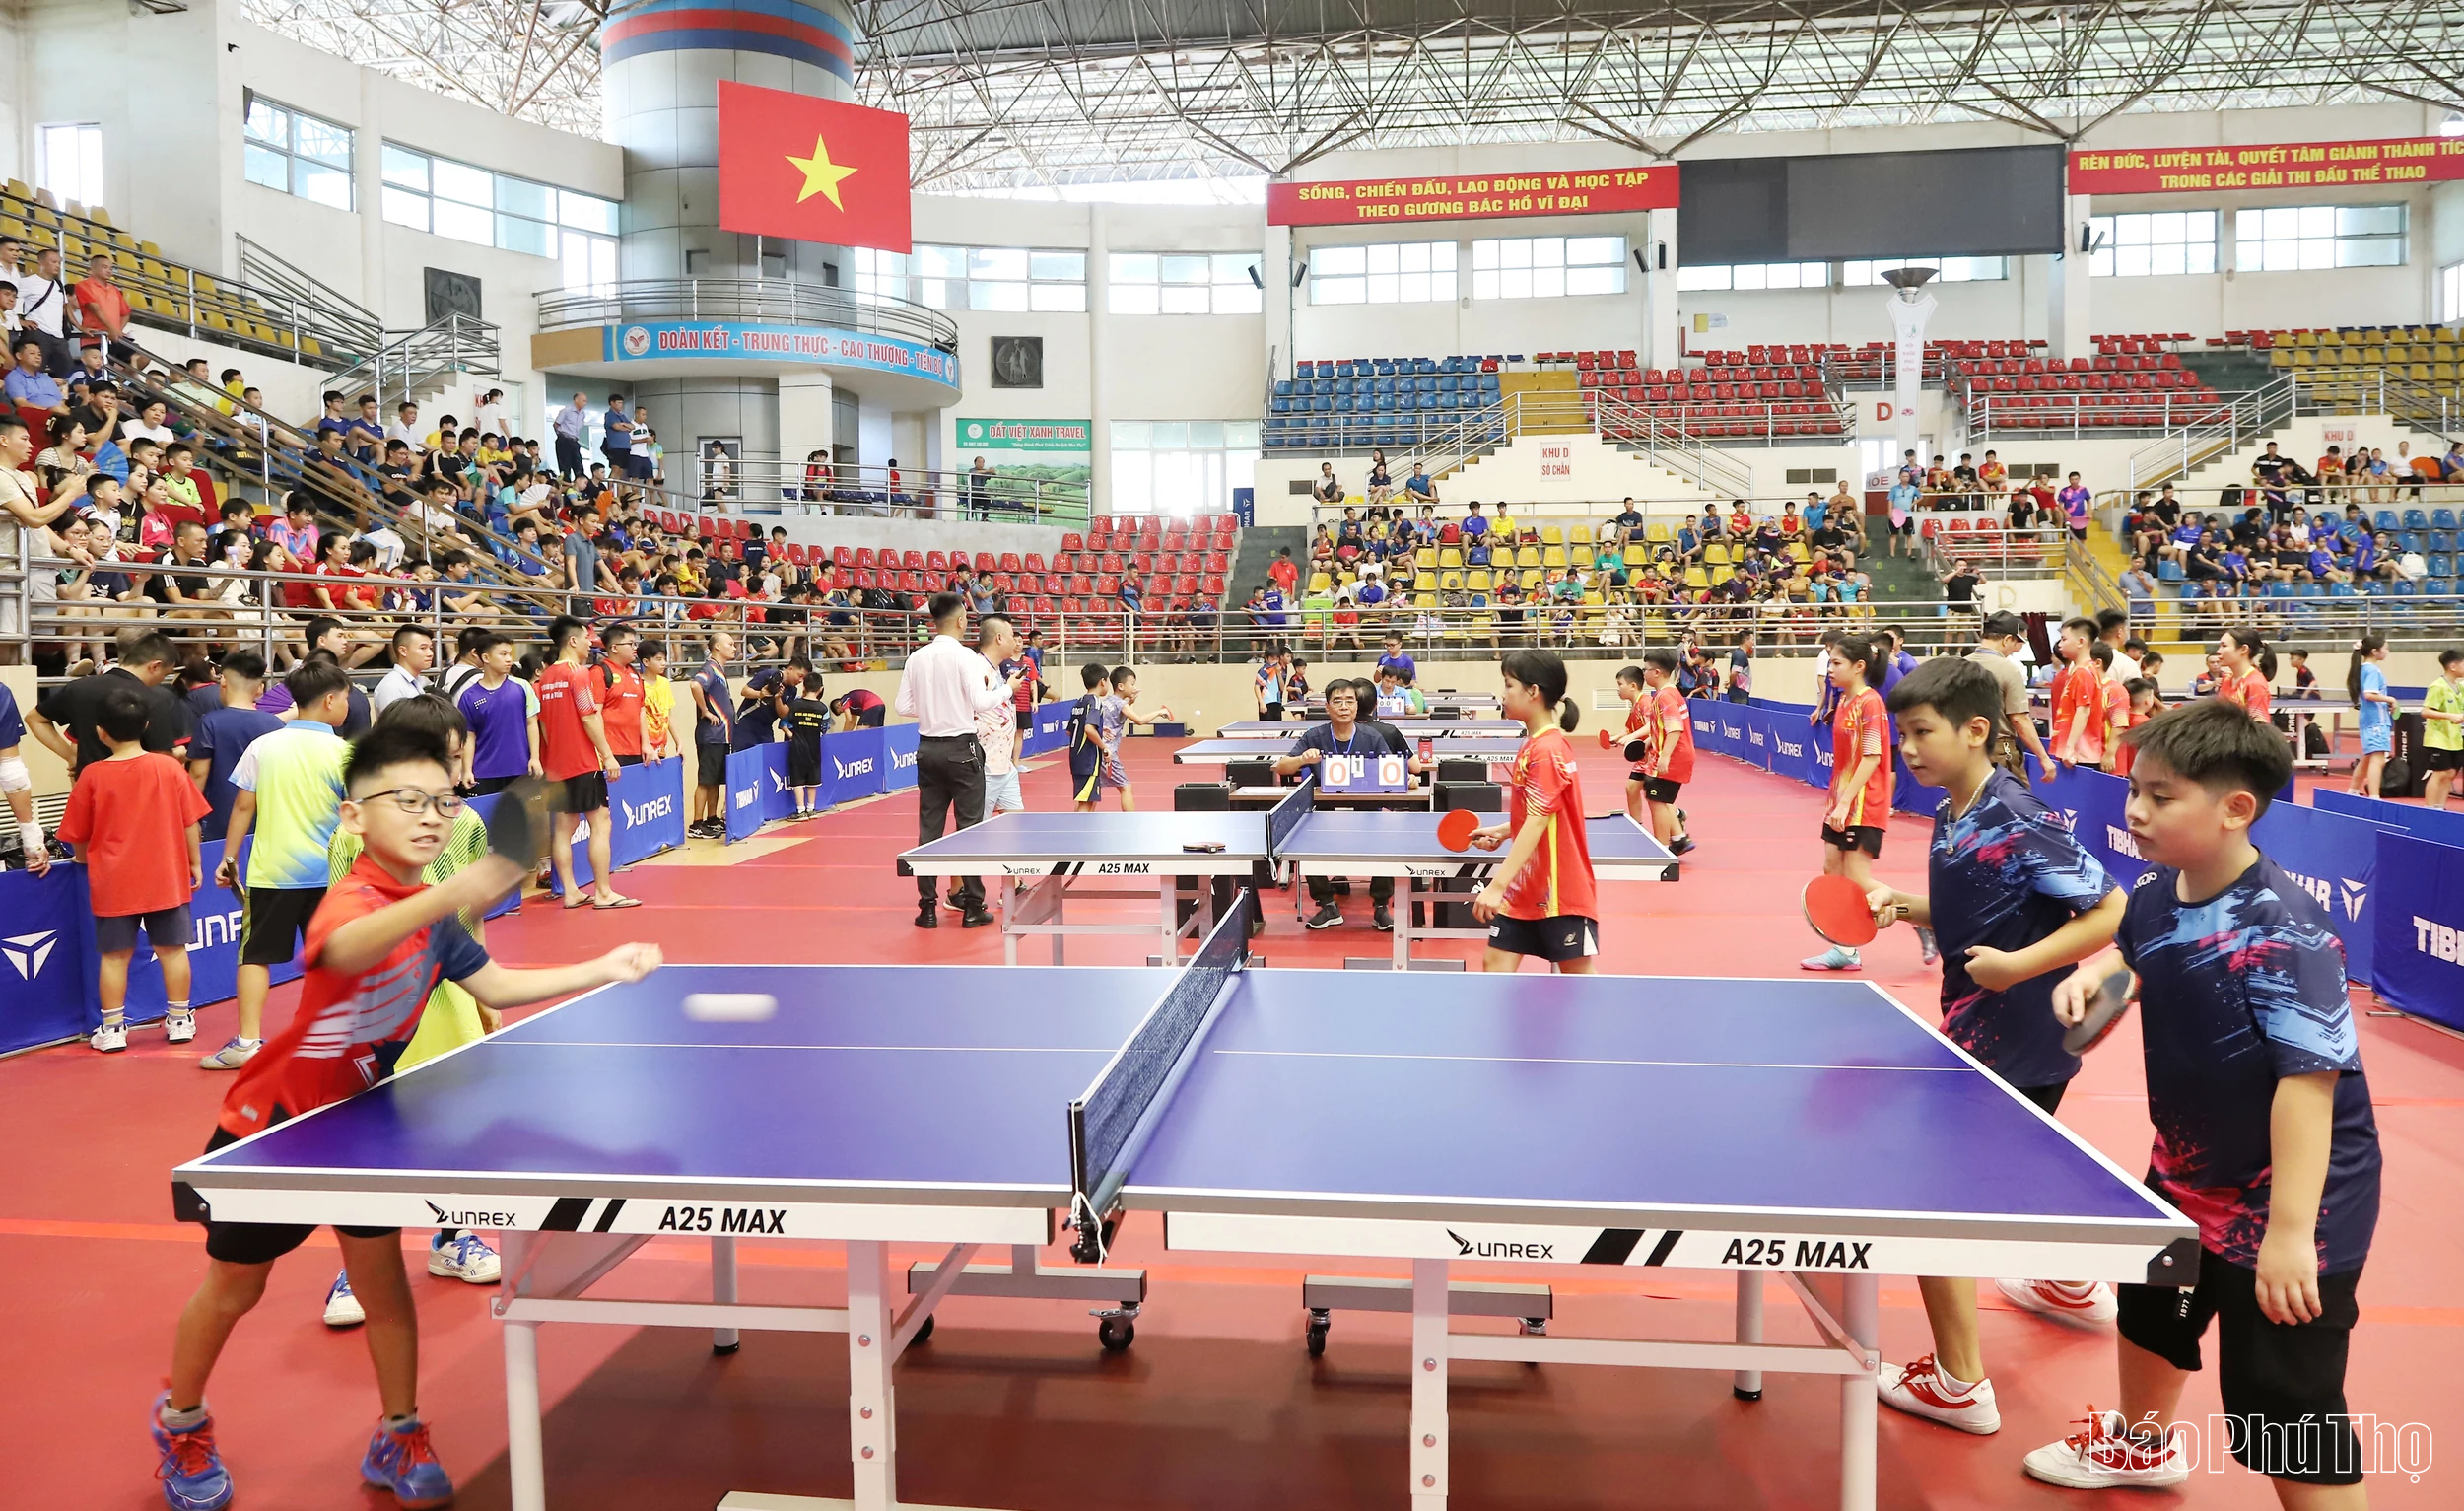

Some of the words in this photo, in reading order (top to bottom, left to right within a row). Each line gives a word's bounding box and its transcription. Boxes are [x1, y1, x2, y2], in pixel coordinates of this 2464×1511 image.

[2080, 154, 2109, 170] RÈN
[2114, 153, 2149, 169] ĐỨC,
[2154, 151, 2201, 169] LUYỆN
[2206, 150, 2234, 166] TÀI,
[2238, 146, 2287, 166] QUYẾT
[2291, 147, 2324, 162] TÂM
[2329, 145, 2378, 161] GIÀNH
[2382, 142, 2434, 158] THÀNH
[2439, 139, 2464, 155] TÍC
[1298, 184, 1350, 200] SỐNG,
[1355, 181, 1406, 198] CHIẾN
[1411, 179, 1451, 196] ĐẤU,
[1457, 180, 1489, 194] LAO
[1494, 177, 1541, 193] ĐỘNG
[1547, 175, 1569, 190] VÀ
[1574, 175, 1609, 190] HỌC
[1615, 172, 1649, 187] TẬP
[2160, 175, 2211, 188] TRONG
[2215, 172, 2246, 187] CÁC
[2251, 168, 2282, 185] GIẢI
[2287, 171, 2310, 184] THI
[2314, 166, 2347, 182] ĐẤU
[2351, 163, 2381, 181] THỂ
[2384, 166, 2426, 179] THAO
[1357, 204, 1399, 218] THEO
[1404, 201, 1463, 216] GƯƠNG
[1469, 198, 1503, 213] BÁC
[1538, 195, 1554, 210] VĨ
[1559, 196, 1588, 211] ĐẠI
[659, 326, 699, 350] ĐOÀN
[703, 325, 729, 350] KẾT
[742, 332, 789, 352] TRUNG
[793, 335, 828, 357] THỰC
[841, 339, 864, 359] CAO
[867, 343, 909, 367] THƯỢNG
[915, 349, 932, 372] TIẾN
[1877, 402, 1893, 421] D
[990, 422, 1007, 439] ĐẤT
[1008, 423, 1027, 441] VIỆT
[1029, 426, 1053, 439] XANH
[1055, 426, 1086, 439] TRAVEL
[2324, 431, 2344, 442] KHU
[2347, 430, 2354, 442] D
[1542, 448, 1560, 458] KHU
[1563, 447, 1569, 458] D
[1998, 585, 2017, 608] D
[1023, 728, 1033, 740] REX
[899, 751, 918, 768] UNRE
[1782, 741, 1802, 757] UNREX
[845, 758, 873, 779] UNREX
[1329, 762, 1347, 785] 0
[1355, 760, 1361, 773] 1
[1383, 762, 1401, 785] 0
[735, 787, 753, 810] TIBHAR
[636, 794, 672, 826] UNREX
[1098, 863, 1120, 873] A25
[1124, 863, 1150, 873] MAX
[451, 1211, 516, 1227] UNREX
[658, 1207, 713, 1232] A25
[721, 1208, 787, 1234] MAX
[1477, 1242, 1554, 1260] UNREX
[1722, 1237, 1785, 1268] A25
[1794, 1240, 1873, 1271] MAX
